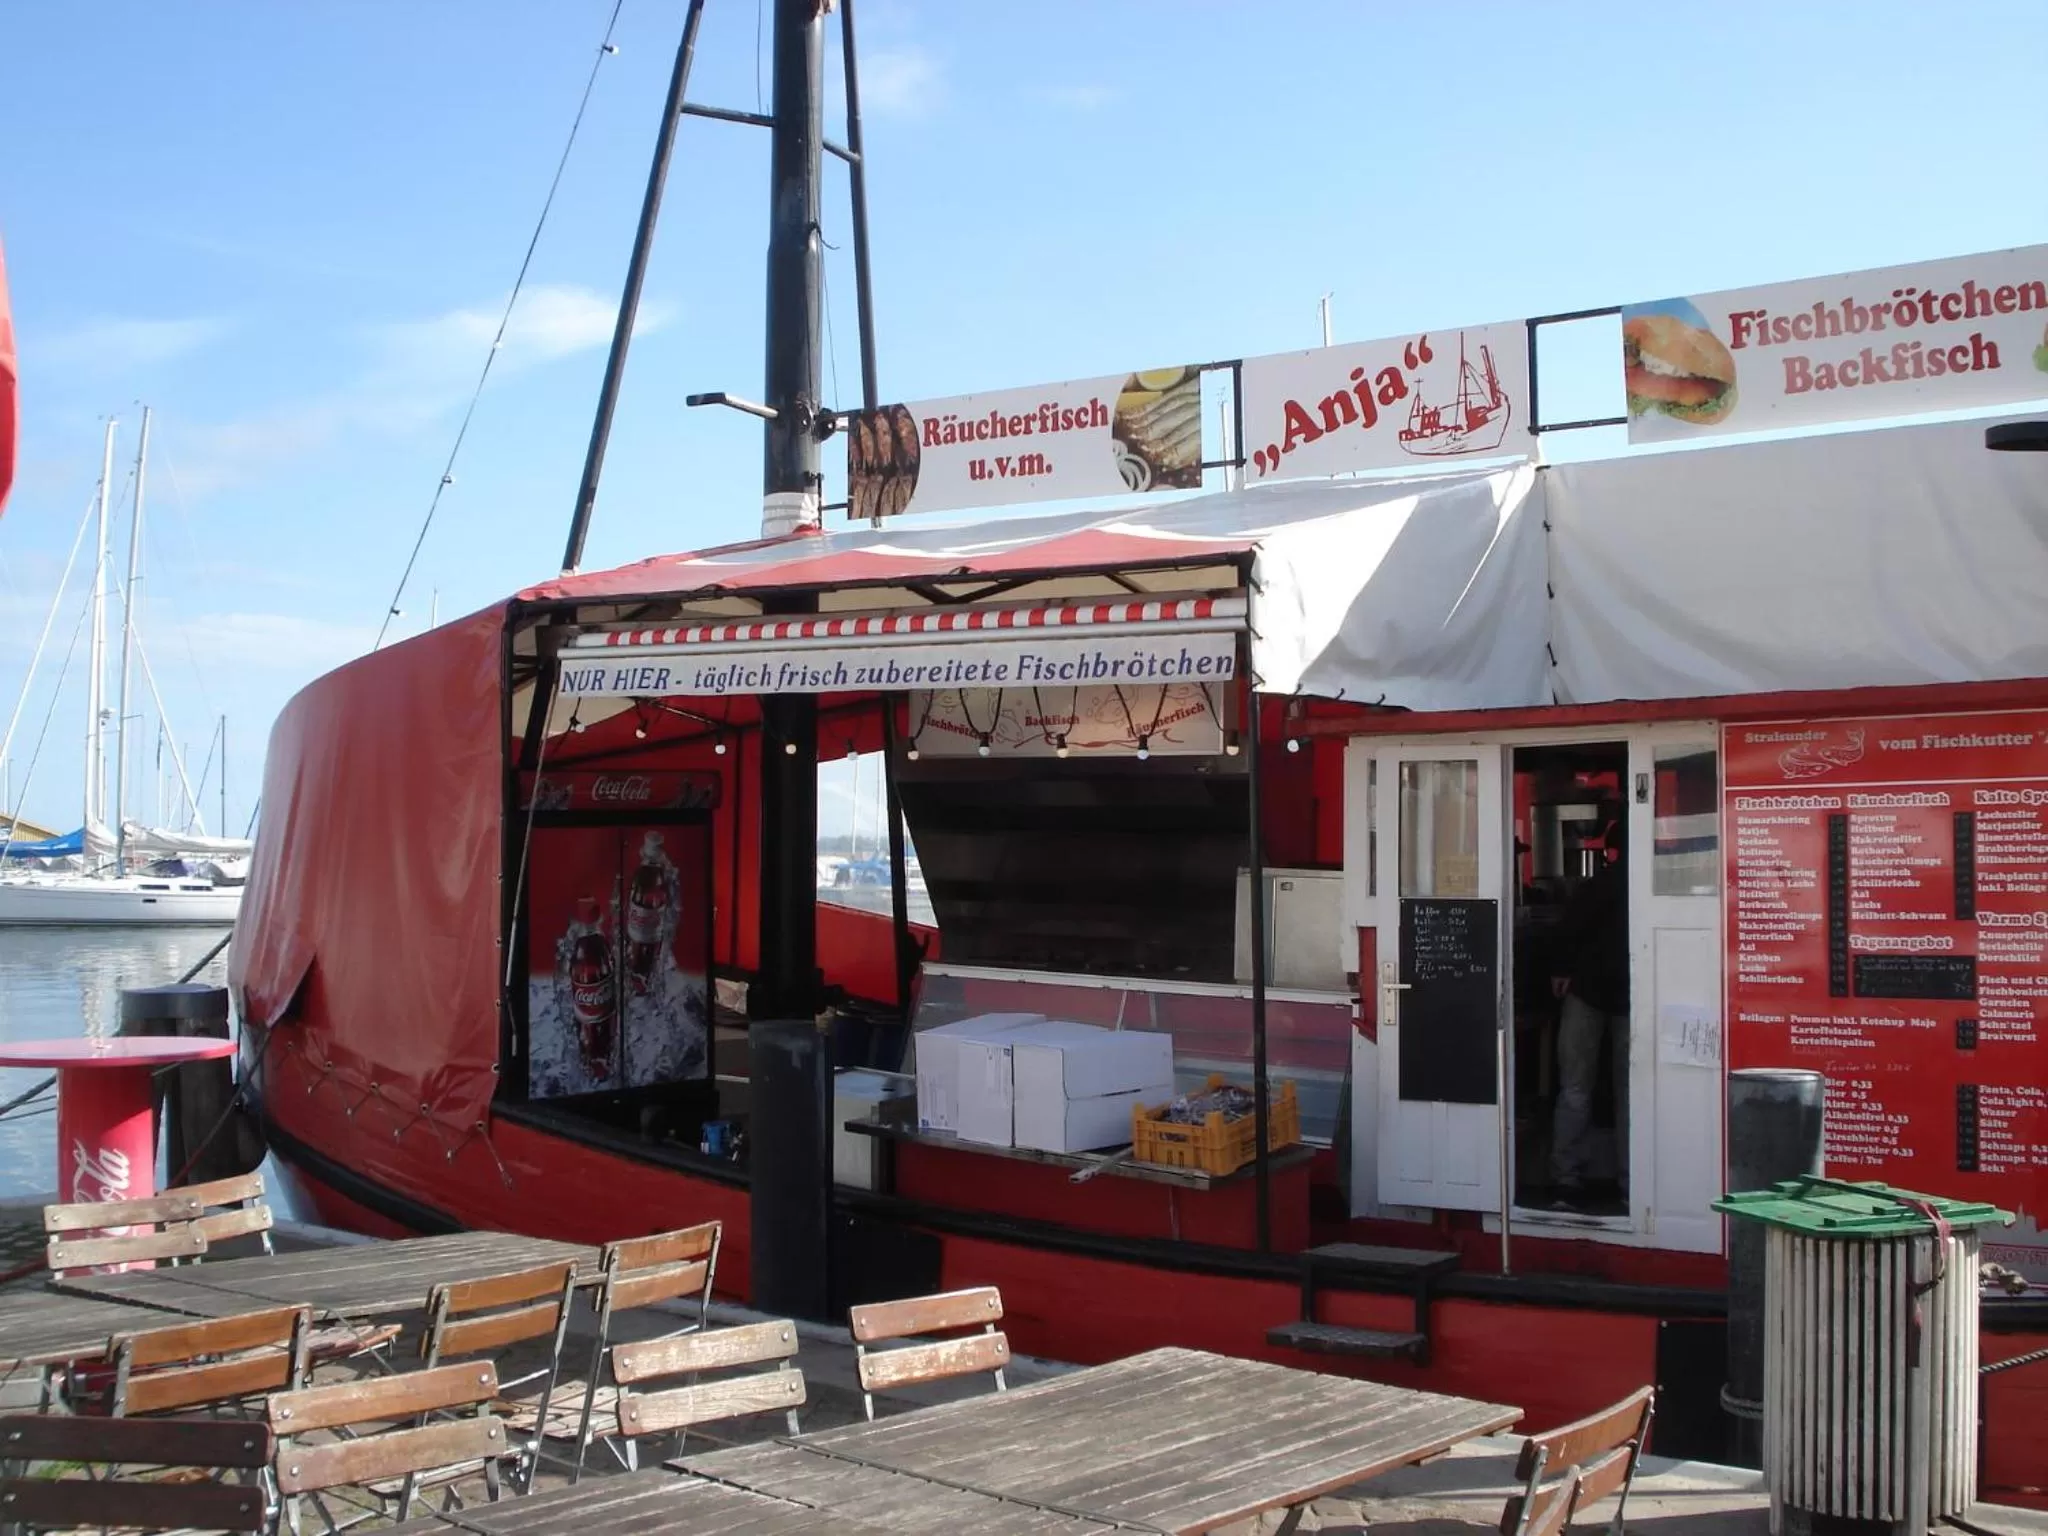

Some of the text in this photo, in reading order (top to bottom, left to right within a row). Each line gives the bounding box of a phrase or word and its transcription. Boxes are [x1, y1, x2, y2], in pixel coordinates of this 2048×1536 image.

[1729, 278, 2048, 350] Fischbrötchen
[1783, 333, 2001, 395] Backfisch
[922, 397, 1109, 448] Räucherfisch
[968, 452, 1053, 481] u.v.m.
[561, 669, 606, 693] NUR
[612, 667, 672, 691] HIER
[694, 663, 772, 693] täglich
[774, 661, 848, 691] frisch
[854, 656, 1008, 684] zubereitete
[1015, 648, 1234, 681] Fischbrötchen
[1744, 731, 1828, 743] Stralsunder
[1878, 738, 1917, 751] vom
[1922, 732, 2033, 749] Fischkutter
[591, 775, 651, 801] Coca-Cola
[1849, 793, 1949, 806] Räucherfisch
[1976, 791, 2018, 803] Kalte
[1737, 797, 1841, 810] Fischbrötchen
[1738, 828, 1769, 836] Matjes
[1851, 825, 1894, 833] Heilbutt
[1851, 836, 1922, 844] Makrelenfilet
[1851, 847, 1904, 855] Rotbarsch
[1851, 868, 1911, 876] Butterfisch
[1851, 890, 1870, 898] Aal
[1739, 901, 1788, 909] Rotbarsch
[1851, 900, 1881, 908] Lachs
[1852, 911, 1947, 920] Heilbutt-Schwanz
[1978, 913, 2031, 926] Warme
[1739, 932, 1794, 940] Butterfisch
[1739, 943, 1756, 951] Aal
[1850, 936, 1953, 952] Tagesangebot
[1739, 953, 1781, 962] Krabben
[1979, 954, 2041, 962] Dorschfilet
[1739, 964, 1766, 972] Lachs
[1979, 976, 2008, 984] Fisch
[1979, 998, 2030, 1007] Garnelen
[1979, 1009, 2034, 1018] Calamaris
[1790, 1014, 1830, 1024] Pommes
[1833, 1015, 1858, 1024] inkl.
[1860, 1017, 1906, 1027] Ketchup
[1911, 1018, 1937, 1028] Majo
[1790, 1025, 1862, 1035] Kartoffelsalat
[1979, 1032, 2037, 1041] Bratwurst
[1790, 1036, 1875, 1048] Kartoffelspalten
[1979, 1085, 2045, 1097] Fanta, Cola,
[1824, 1100, 1856, 1109] Alster
[1979, 1096, 2004, 1106] Cola
[2006, 1098, 2034, 1107] light
[1824, 1111, 1885, 1121] Alkoholfrei
[1980, 1107, 2017, 1117] Wasser
[1824, 1122, 1882, 1132] Weizenbier
[1980, 1118, 2009, 1128] Säfte
[1824, 1132, 1881, 1143] Kirschbier
[1980, 1130, 2013, 1139] Eistee
[1824, 1143, 1890, 1155] Schwarzbier
[1980, 1140, 2026, 1152] Schnaps
[1824, 1154, 1858, 1163] Kaffee
[1866, 1156, 1883, 1164] Tee
[1980, 1151, 2026, 1164] Schnaps
[1980, 1162, 2005, 1173] Sekt
